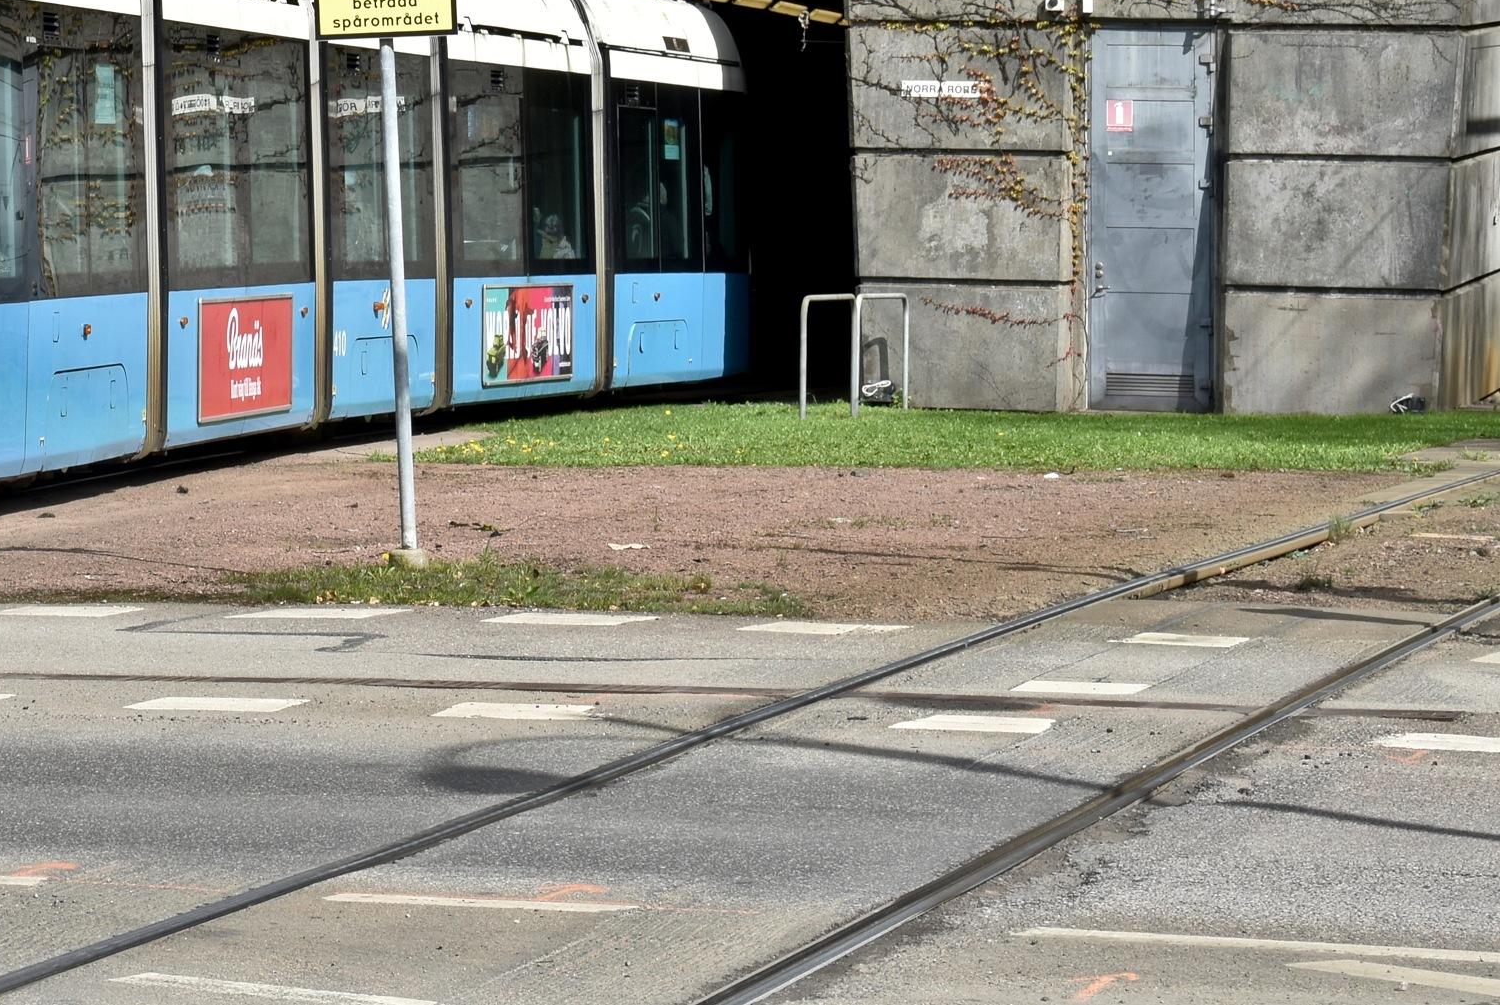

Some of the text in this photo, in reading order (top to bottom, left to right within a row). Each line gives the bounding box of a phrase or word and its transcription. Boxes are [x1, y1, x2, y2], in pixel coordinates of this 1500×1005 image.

[333, 11, 440, 30] spårområdet
[226, 307, 264, 370] Branäs
[333, 329, 347, 357] 410
